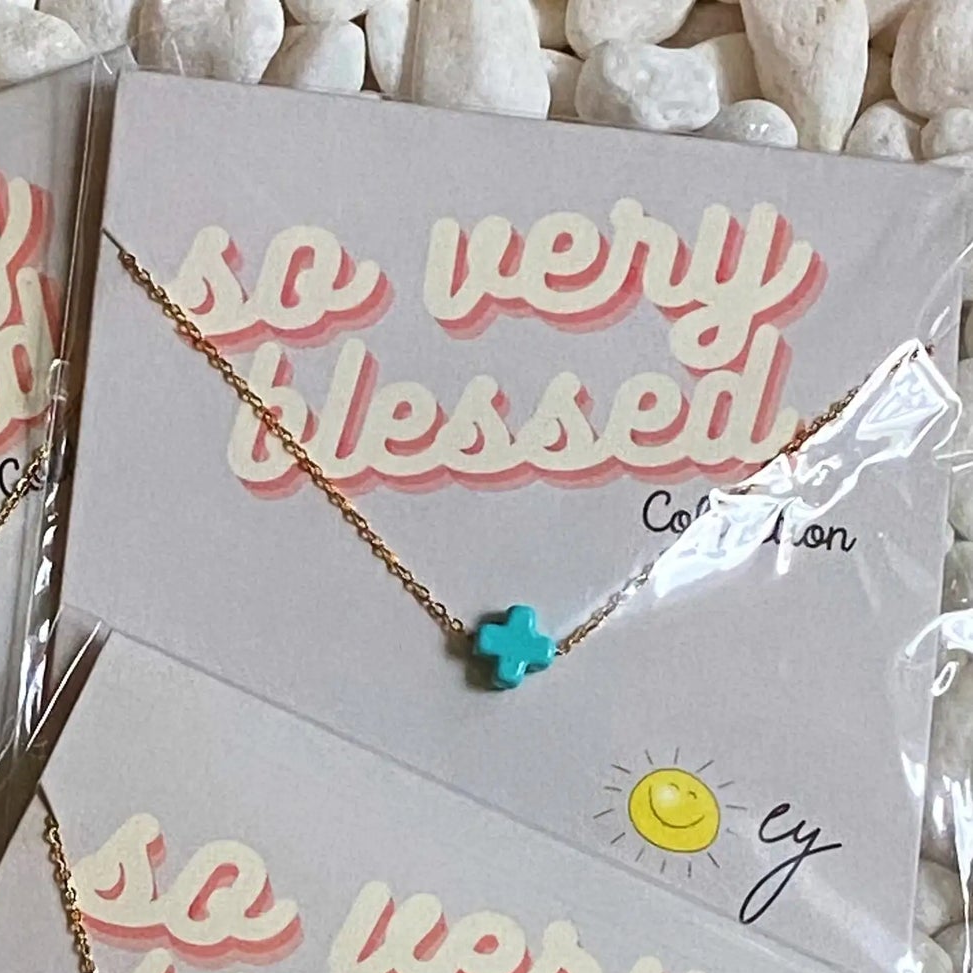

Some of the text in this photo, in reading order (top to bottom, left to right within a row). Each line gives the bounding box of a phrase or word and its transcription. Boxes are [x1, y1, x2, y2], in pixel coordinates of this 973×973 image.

[170, 199, 828, 375] so very
[227, 325, 803, 498] blessed
[72, 812, 303, 964] so
